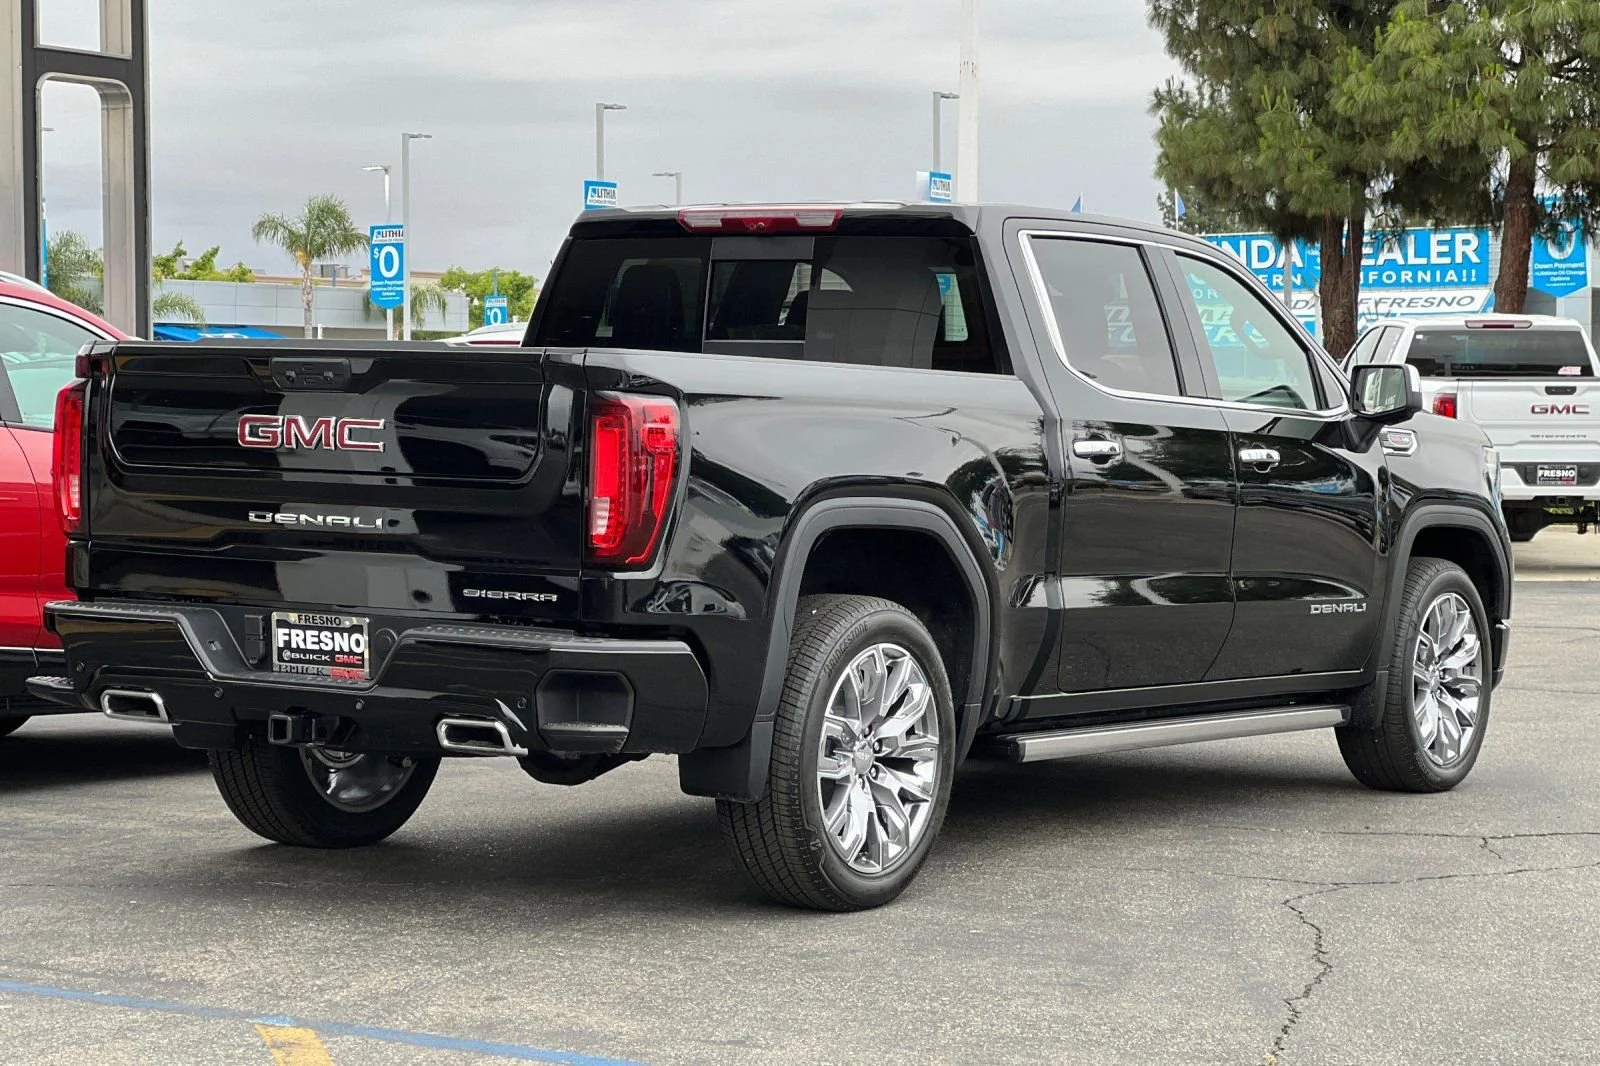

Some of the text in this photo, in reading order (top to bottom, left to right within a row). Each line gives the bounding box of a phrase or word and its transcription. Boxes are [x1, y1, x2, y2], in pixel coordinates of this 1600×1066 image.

[1209, 232, 1481, 270] NDA EALER
[1360, 269, 1477, 285] IFORNIA!!
[1377, 295, 1476, 308] FRESNO
[1531, 403, 1590, 415] GMC
[237, 413, 386, 453] GMC
[1538, 469, 1576, 478] FRESNO
[249, 510, 383, 530] DENALI
[463, 588, 558, 602] SIERRA
[1310, 602, 1367, 615] DENALI
[297, 614, 342, 626] FRESNO
[277, 628, 365, 654] FRESNO
[291, 652, 363, 665] BUICK GMC
